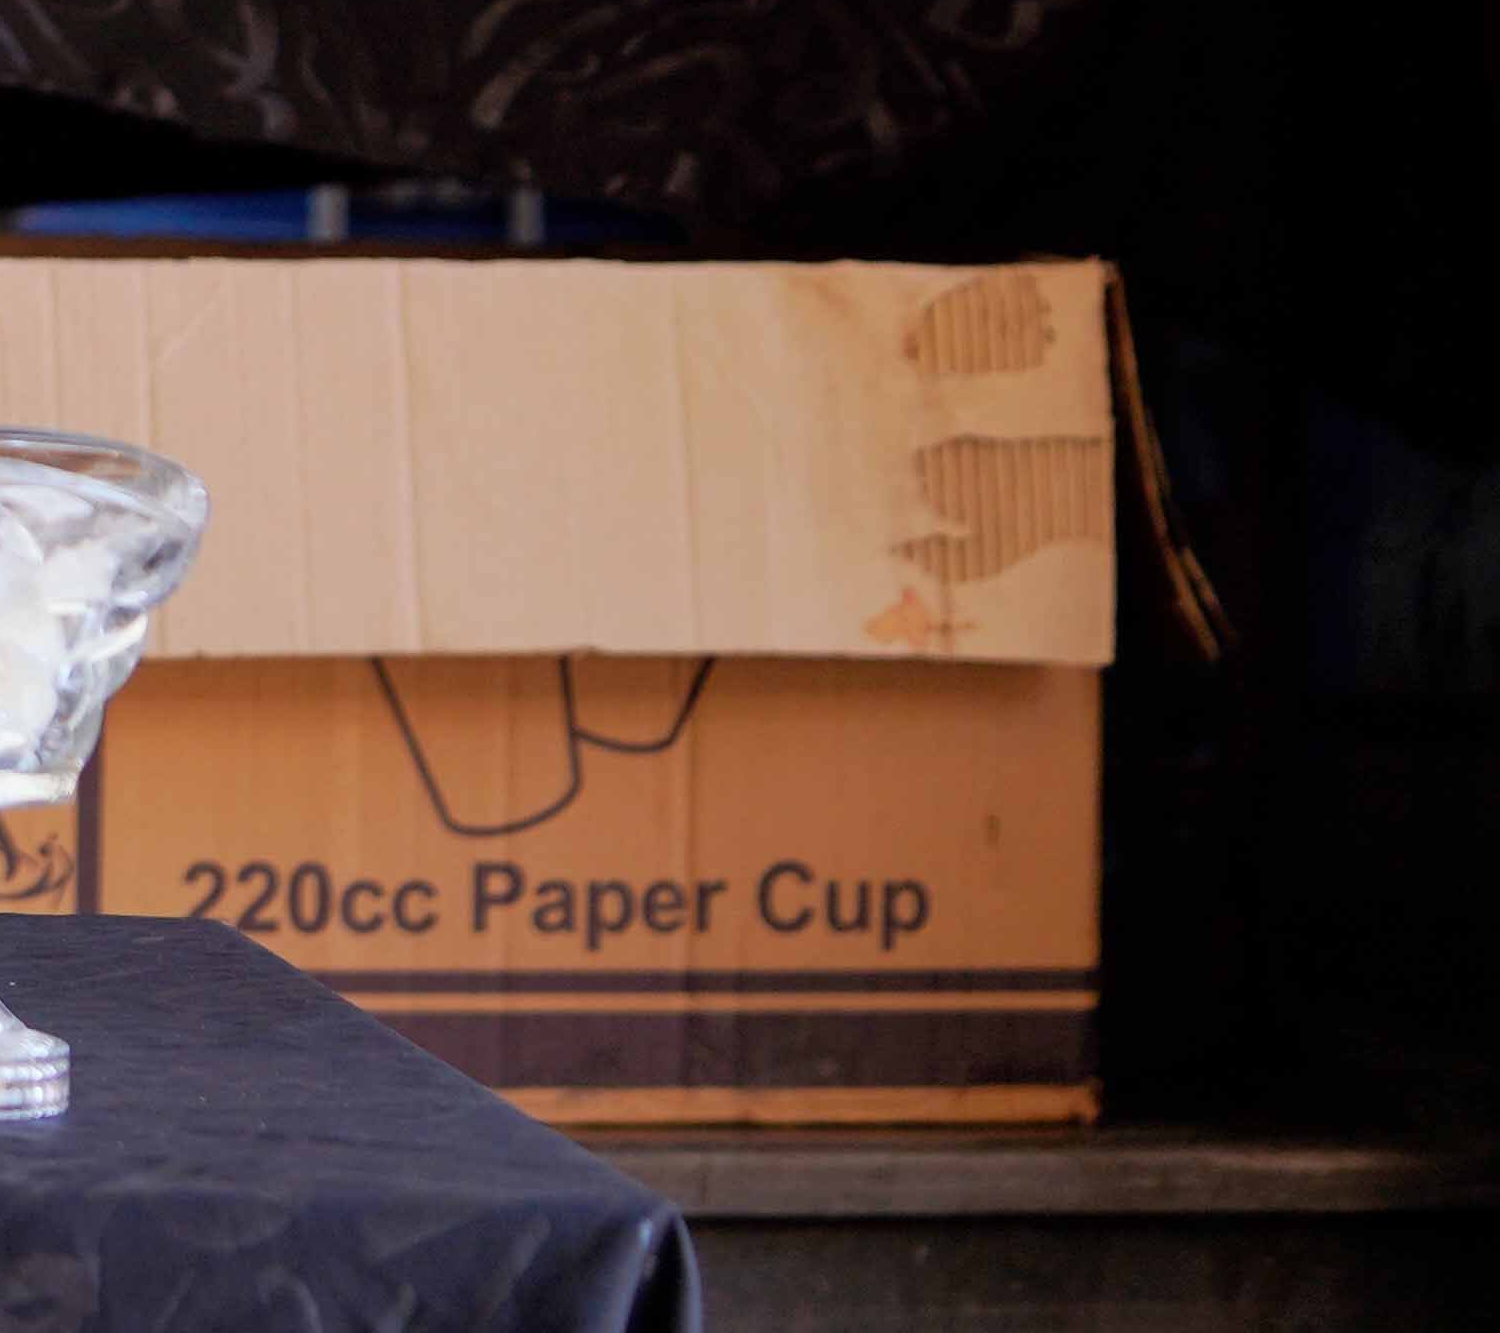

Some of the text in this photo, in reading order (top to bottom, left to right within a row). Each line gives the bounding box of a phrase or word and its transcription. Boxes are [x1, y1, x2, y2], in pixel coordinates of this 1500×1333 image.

[181, 859, 931, 952] 220cc Paper Cup
